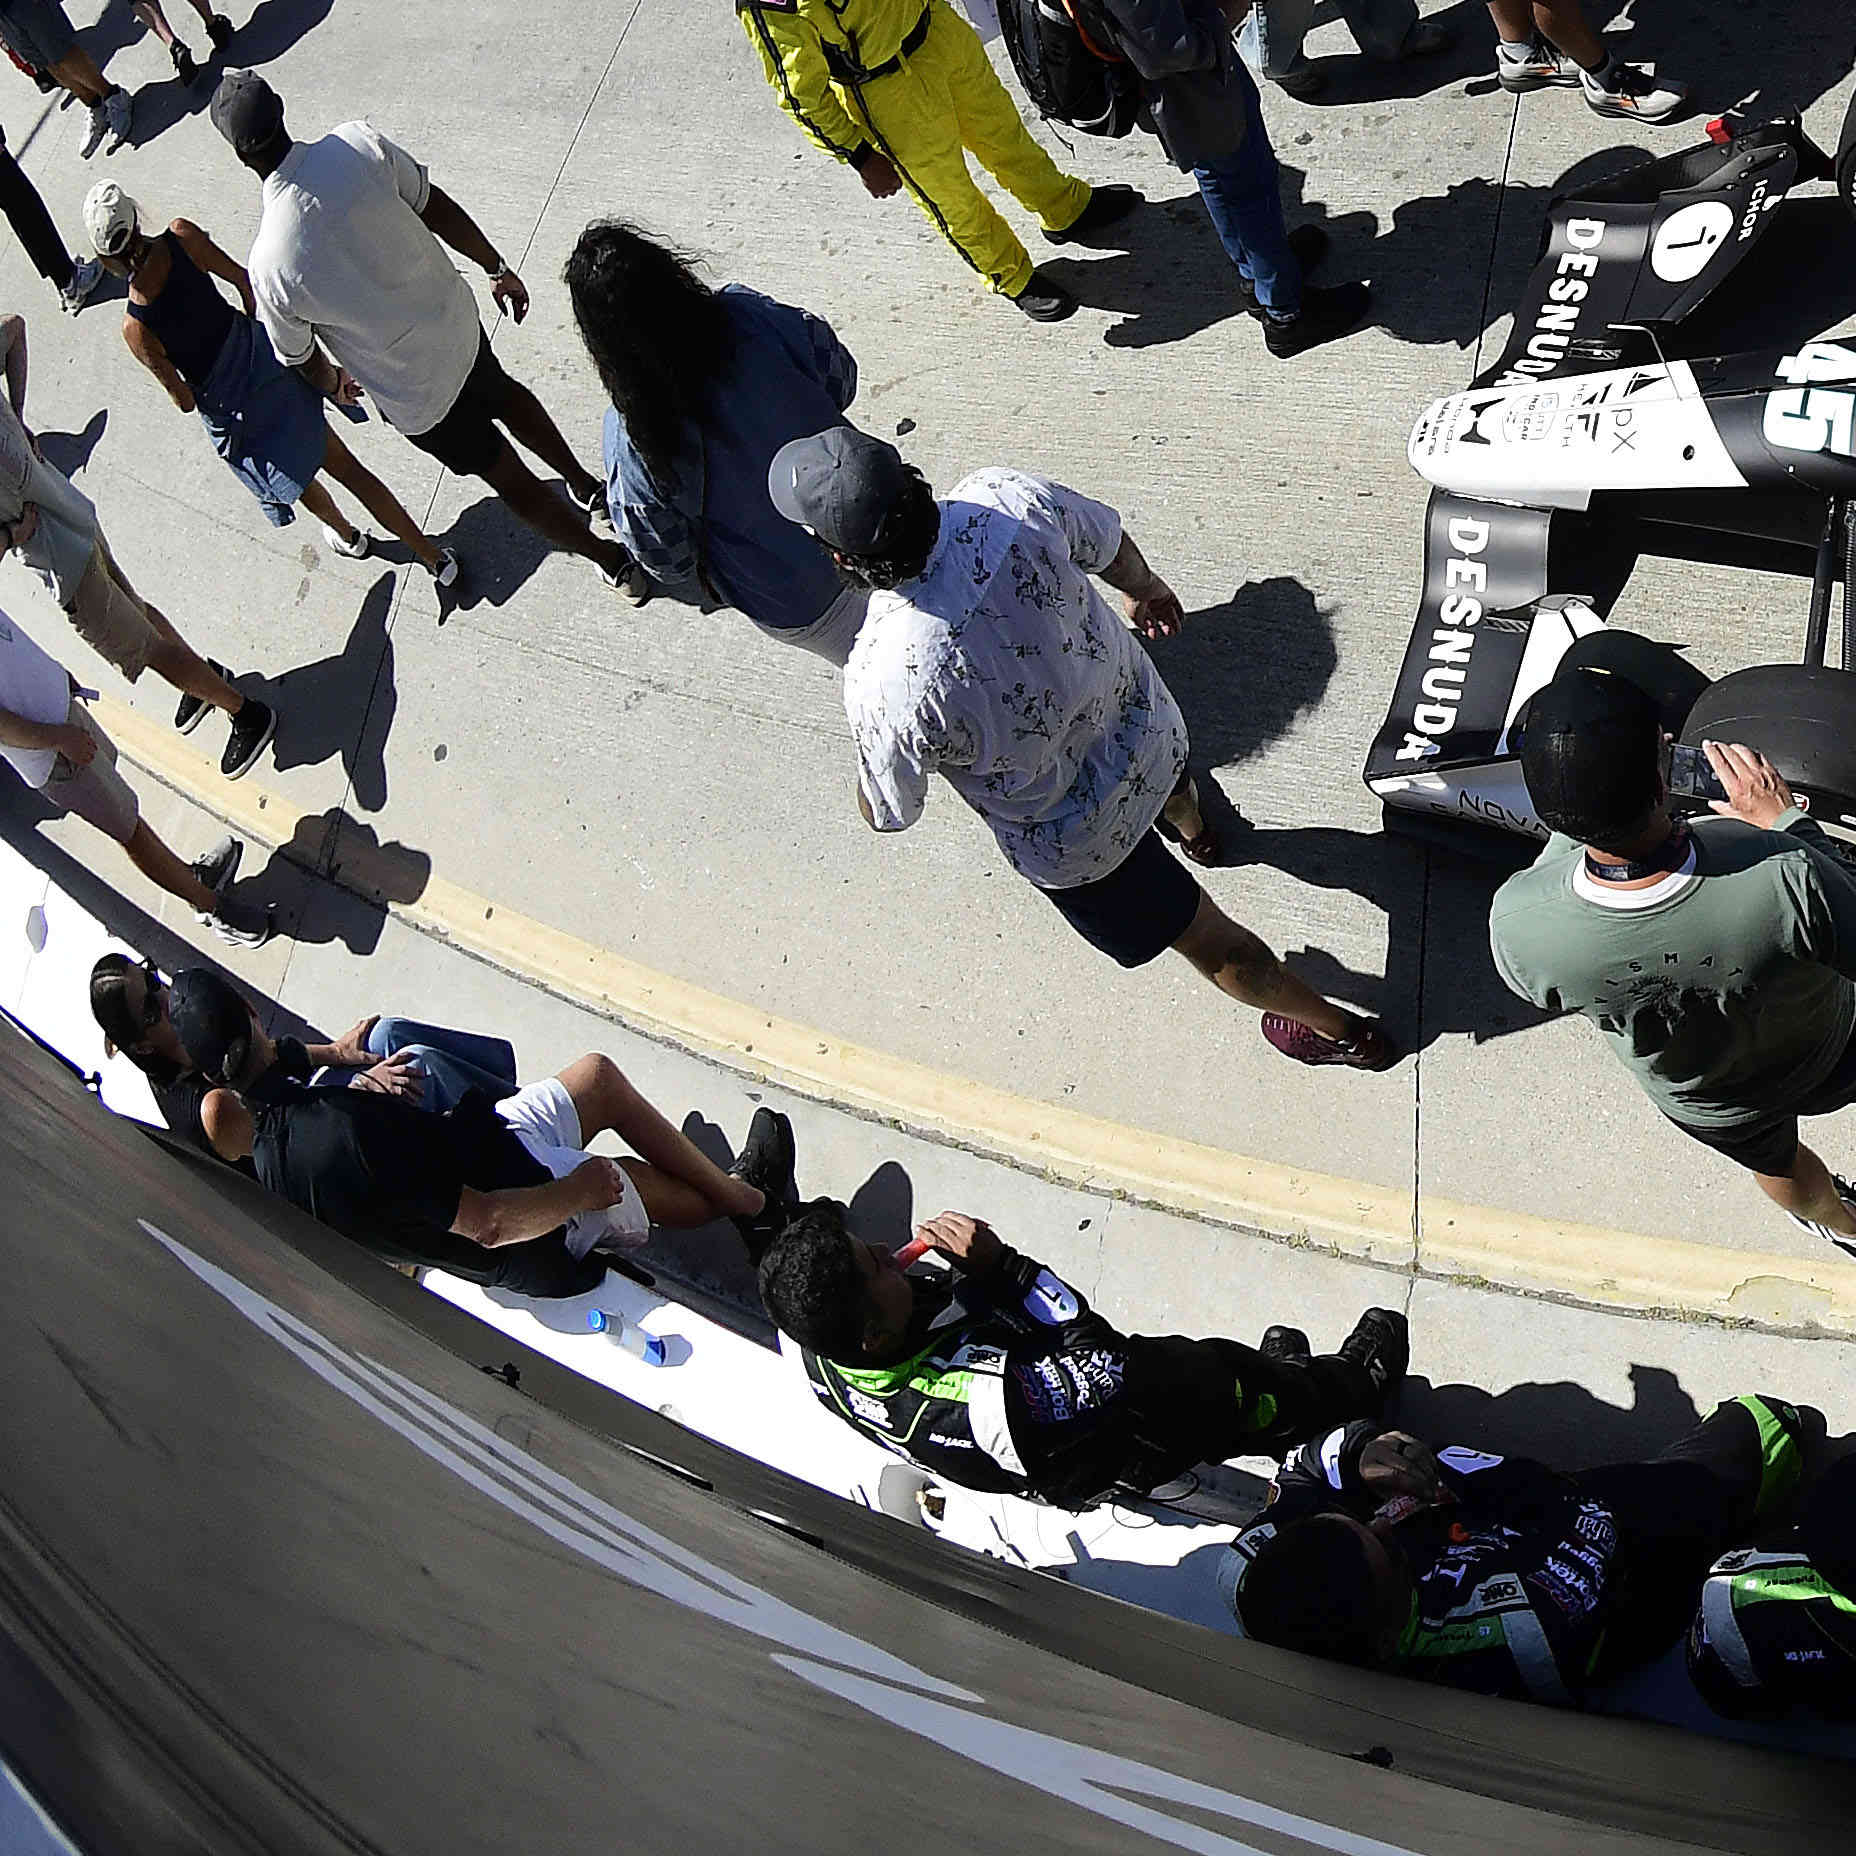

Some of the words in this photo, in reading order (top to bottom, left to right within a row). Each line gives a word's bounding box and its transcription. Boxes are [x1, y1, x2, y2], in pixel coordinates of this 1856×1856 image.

[1737, 179, 1768, 241] ICHOR
[1496, 217, 1607, 390] DESNUDA
[1394, 515, 1492, 762] DESNUDA
